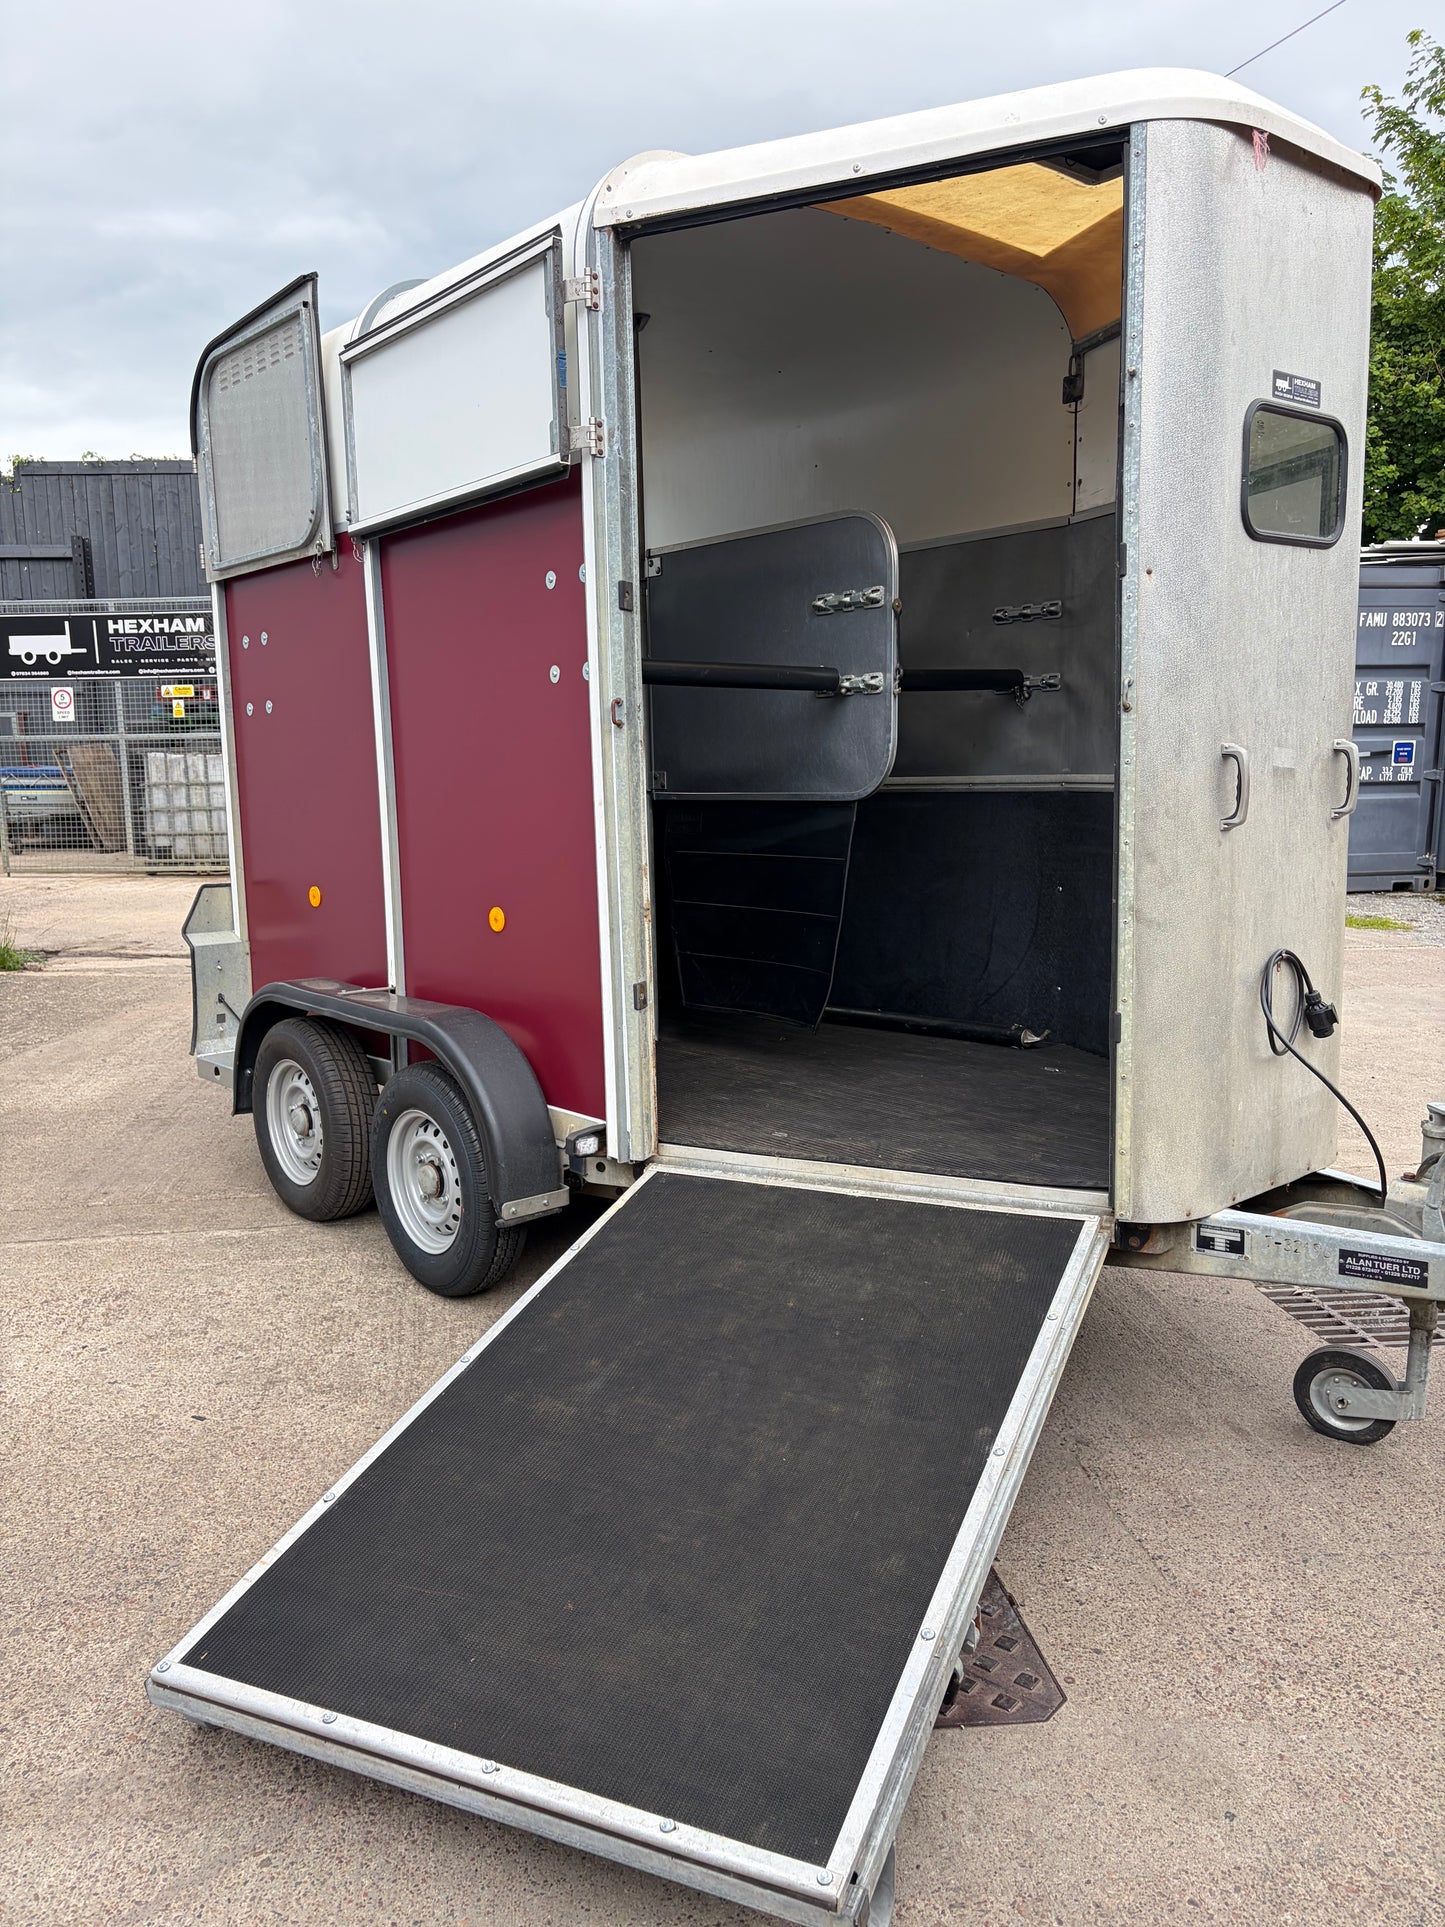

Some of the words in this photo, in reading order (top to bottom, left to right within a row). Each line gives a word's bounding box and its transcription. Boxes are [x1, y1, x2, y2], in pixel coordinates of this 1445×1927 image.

[1294, 378, 1316, 389] HEXHAM
[107, 618, 205, 634] HEXHAM
[1360, 612, 1387, 627] FAMU
[1392, 612, 1431, 627] 883073
[1436, 611, 1443, 626] 2
[109, 635, 216, 652] TRAILERS
[1391, 631, 1416, 646] 22G1
[1366, 681, 1379, 696] GR.
[60, 693, 65, 701] 5
[1346, 1257, 1372, 1267] ALAN
[1373, 1261, 1400, 1272] TUER
[1402, 1265, 1421, 1275] LTD
